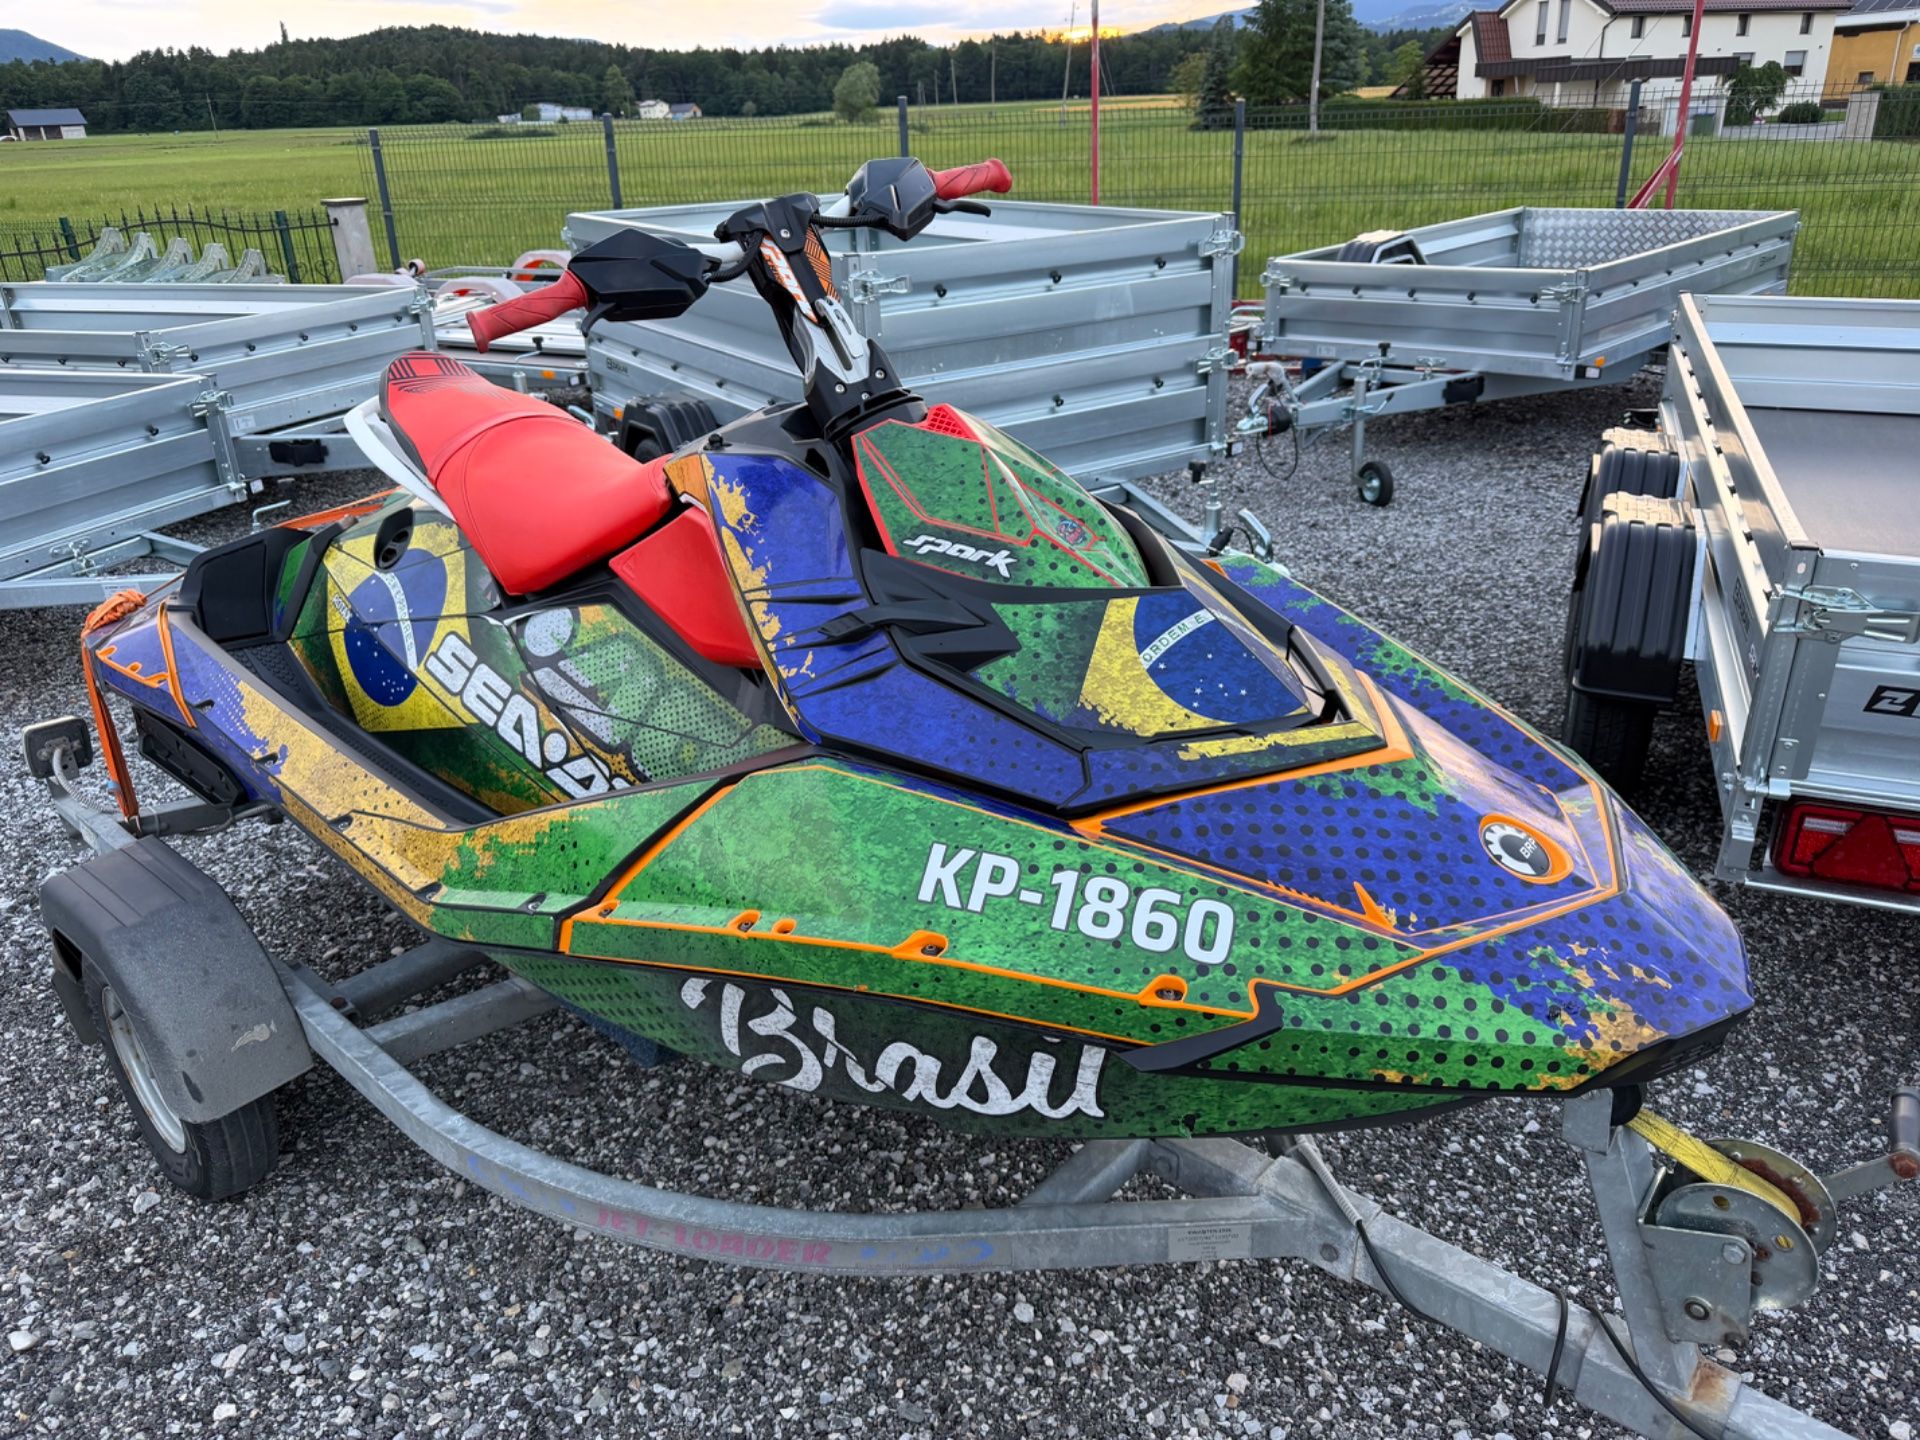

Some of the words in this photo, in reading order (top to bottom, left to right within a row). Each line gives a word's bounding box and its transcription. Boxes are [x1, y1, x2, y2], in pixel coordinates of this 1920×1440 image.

[903, 534, 1017, 578] spark
[1142, 622, 1190, 662] ORDEM
[1194, 614, 1204, 624] E
[1519, 837, 1538, 859] BRP
[917, 841, 1235, 965] KP-1860
[680, 977, 1106, 1119] Brasil
